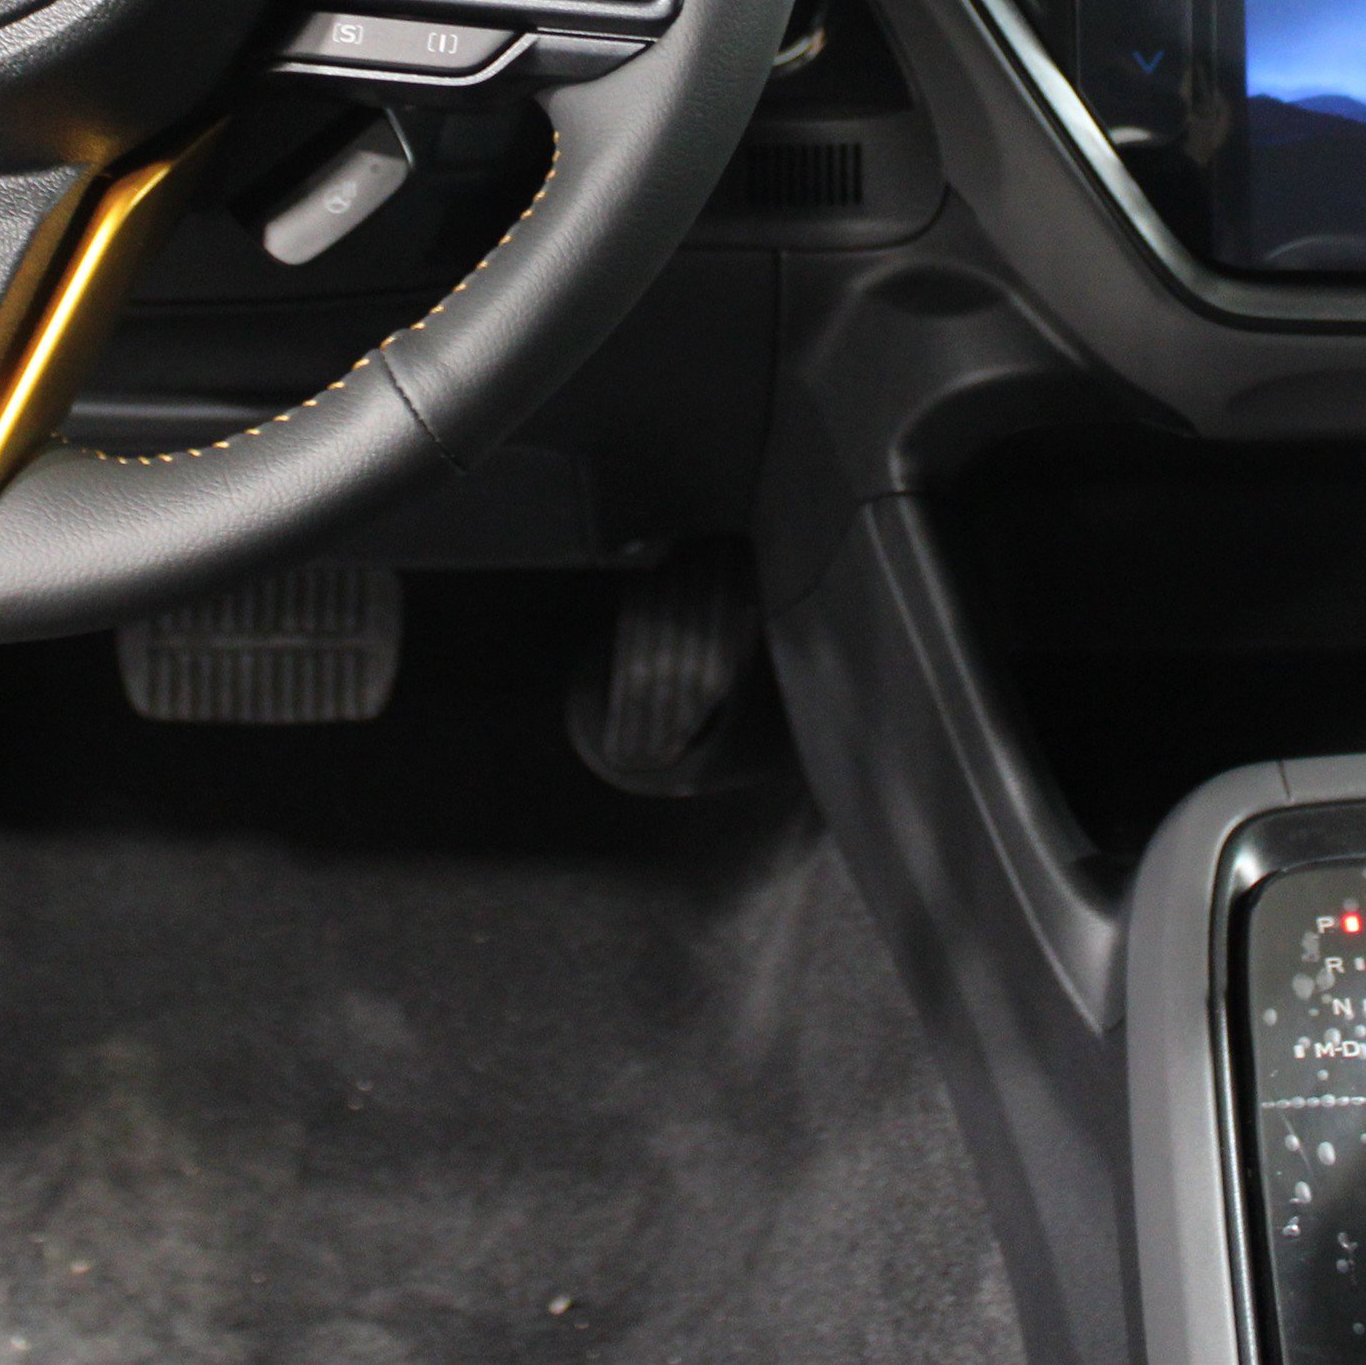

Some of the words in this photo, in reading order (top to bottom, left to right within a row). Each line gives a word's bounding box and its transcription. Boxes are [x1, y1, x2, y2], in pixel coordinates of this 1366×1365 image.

[1316, 915, 1335, 933] P
[1324, 956, 1345, 973] R
[1332, 998, 1353, 1016] N
